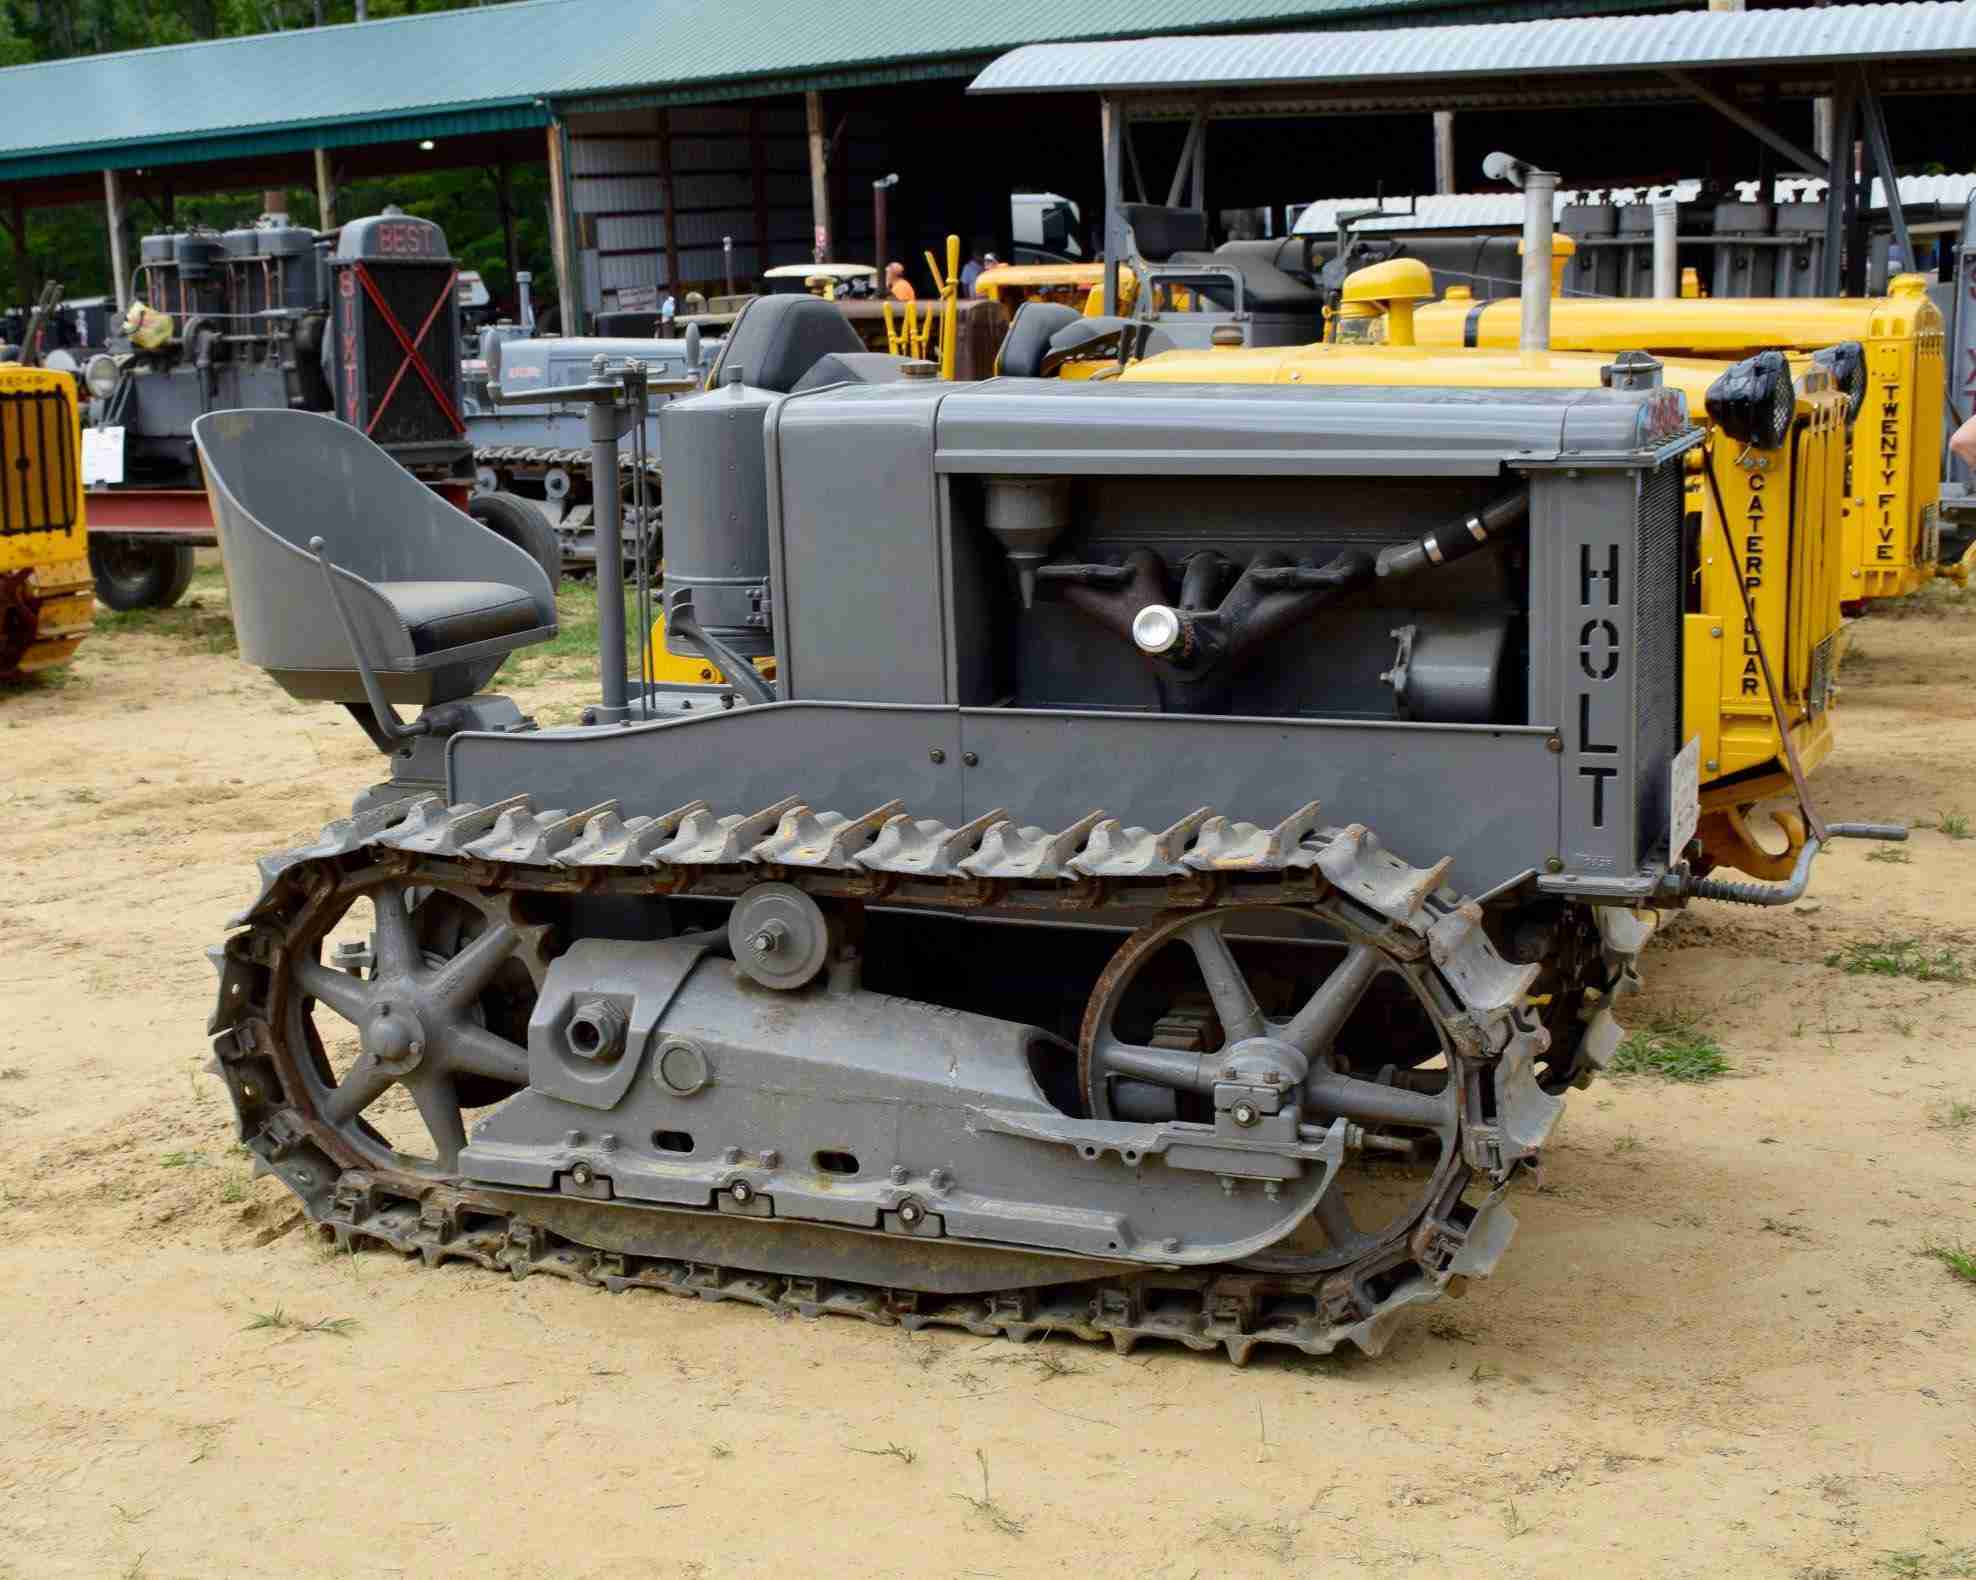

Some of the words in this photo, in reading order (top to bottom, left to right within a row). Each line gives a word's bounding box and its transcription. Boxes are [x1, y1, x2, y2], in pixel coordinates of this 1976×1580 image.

[377, 224, 433, 252] BEST
[339, 269, 360, 428] SIXTY
[1880, 384, 1899, 486] TWENTY
[1876, 494, 1896, 561] FIVE
[1579, 543, 1619, 827] HOLT
